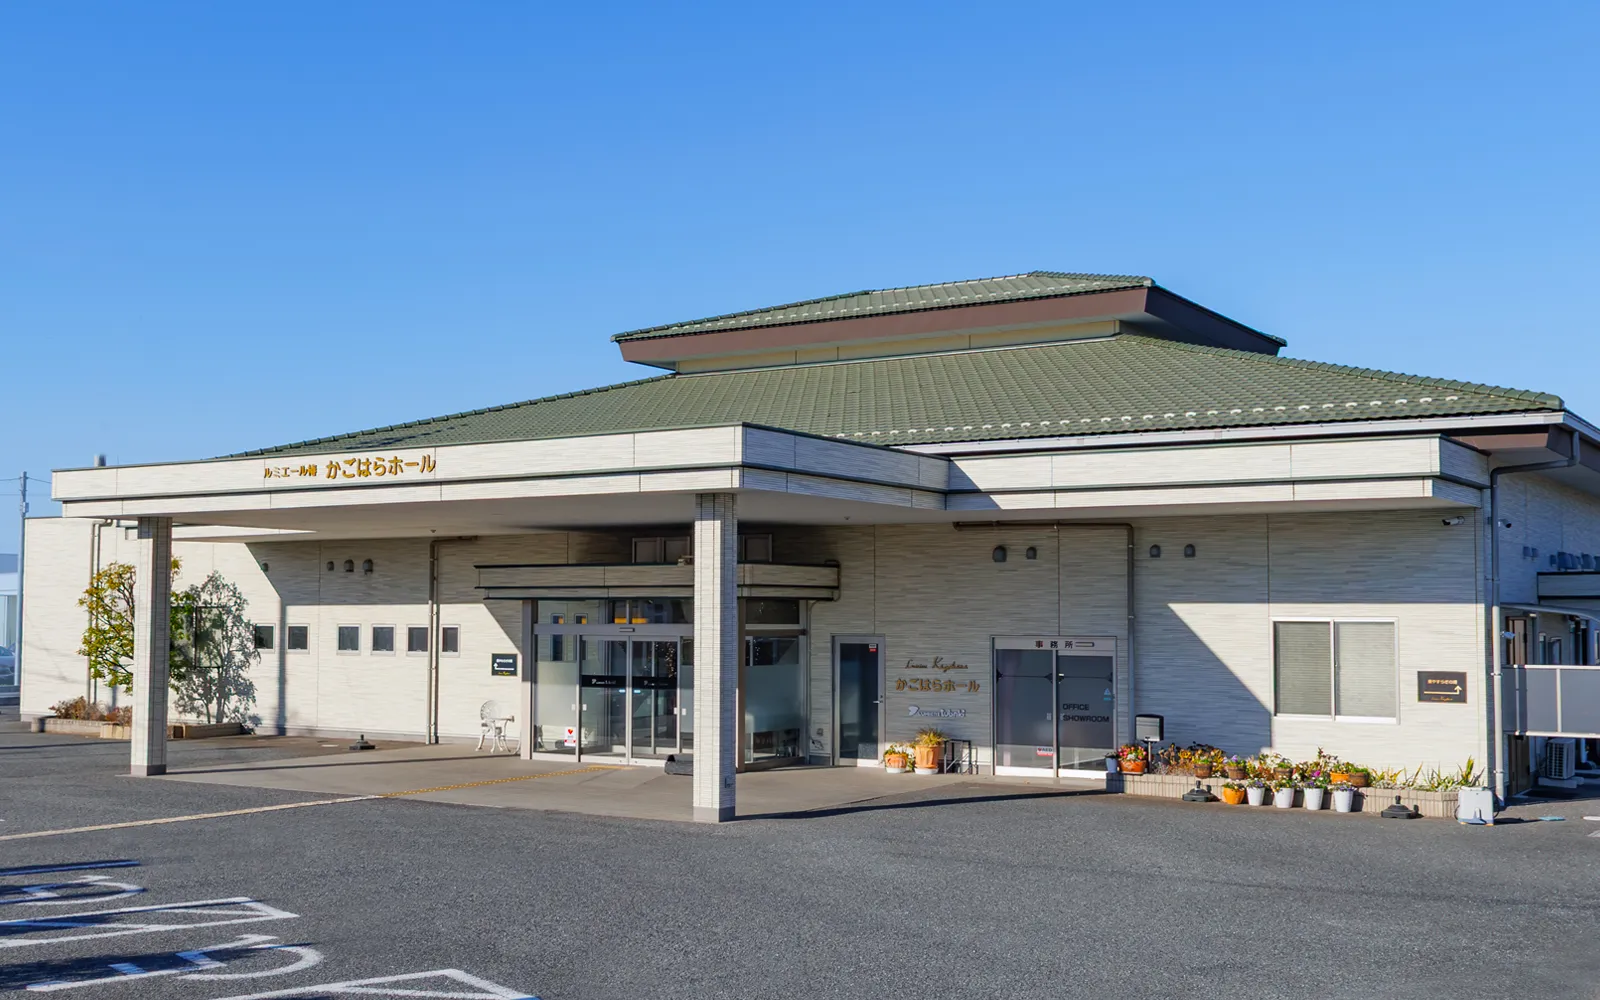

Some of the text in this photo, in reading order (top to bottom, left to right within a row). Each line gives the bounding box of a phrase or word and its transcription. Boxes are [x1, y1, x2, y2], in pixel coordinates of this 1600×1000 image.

[325, 454, 436, 480] かごはらホール
[1035, 640, 1074, 649] 事務所
[895, 677, 981, 693] かごはらホール
[1062, 703, 1090, 711] OFFICE
[1062, 714, 1110, 723] SHOWROOM
